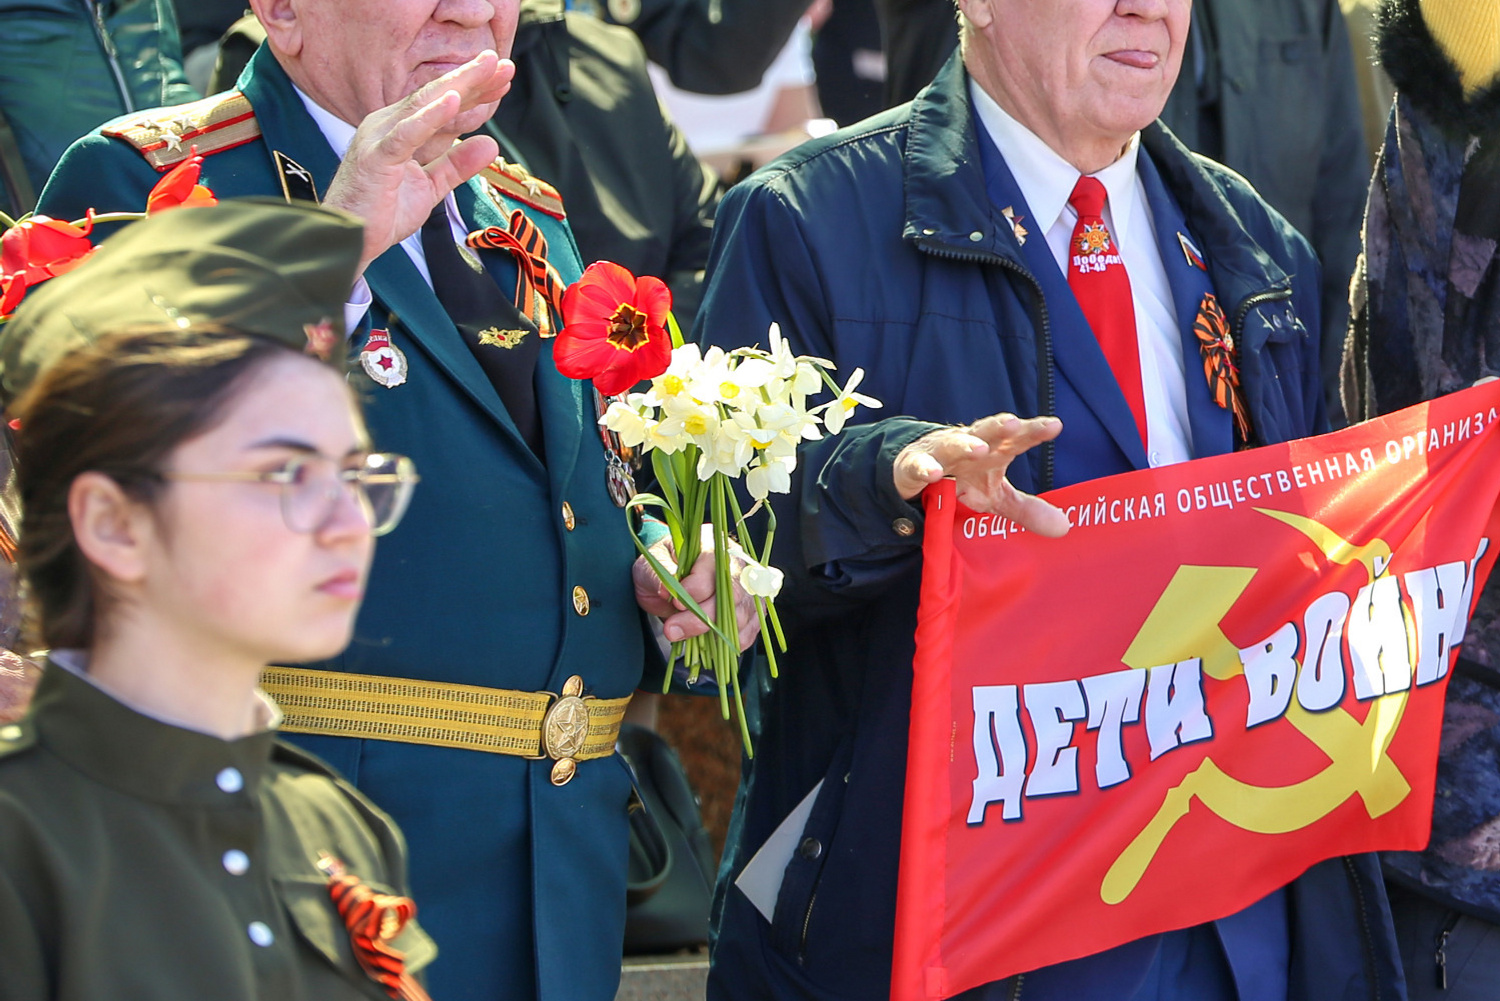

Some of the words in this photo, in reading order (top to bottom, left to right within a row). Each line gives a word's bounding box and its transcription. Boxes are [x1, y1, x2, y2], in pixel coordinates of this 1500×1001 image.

[963, 493, 1165, 540] ОБЩСИЙСКАЯ
[1177, 448, 1376, 513] ОБЩЕСТВЕННАЯ
[968, 658, 1213, 825] ДЕТИ
